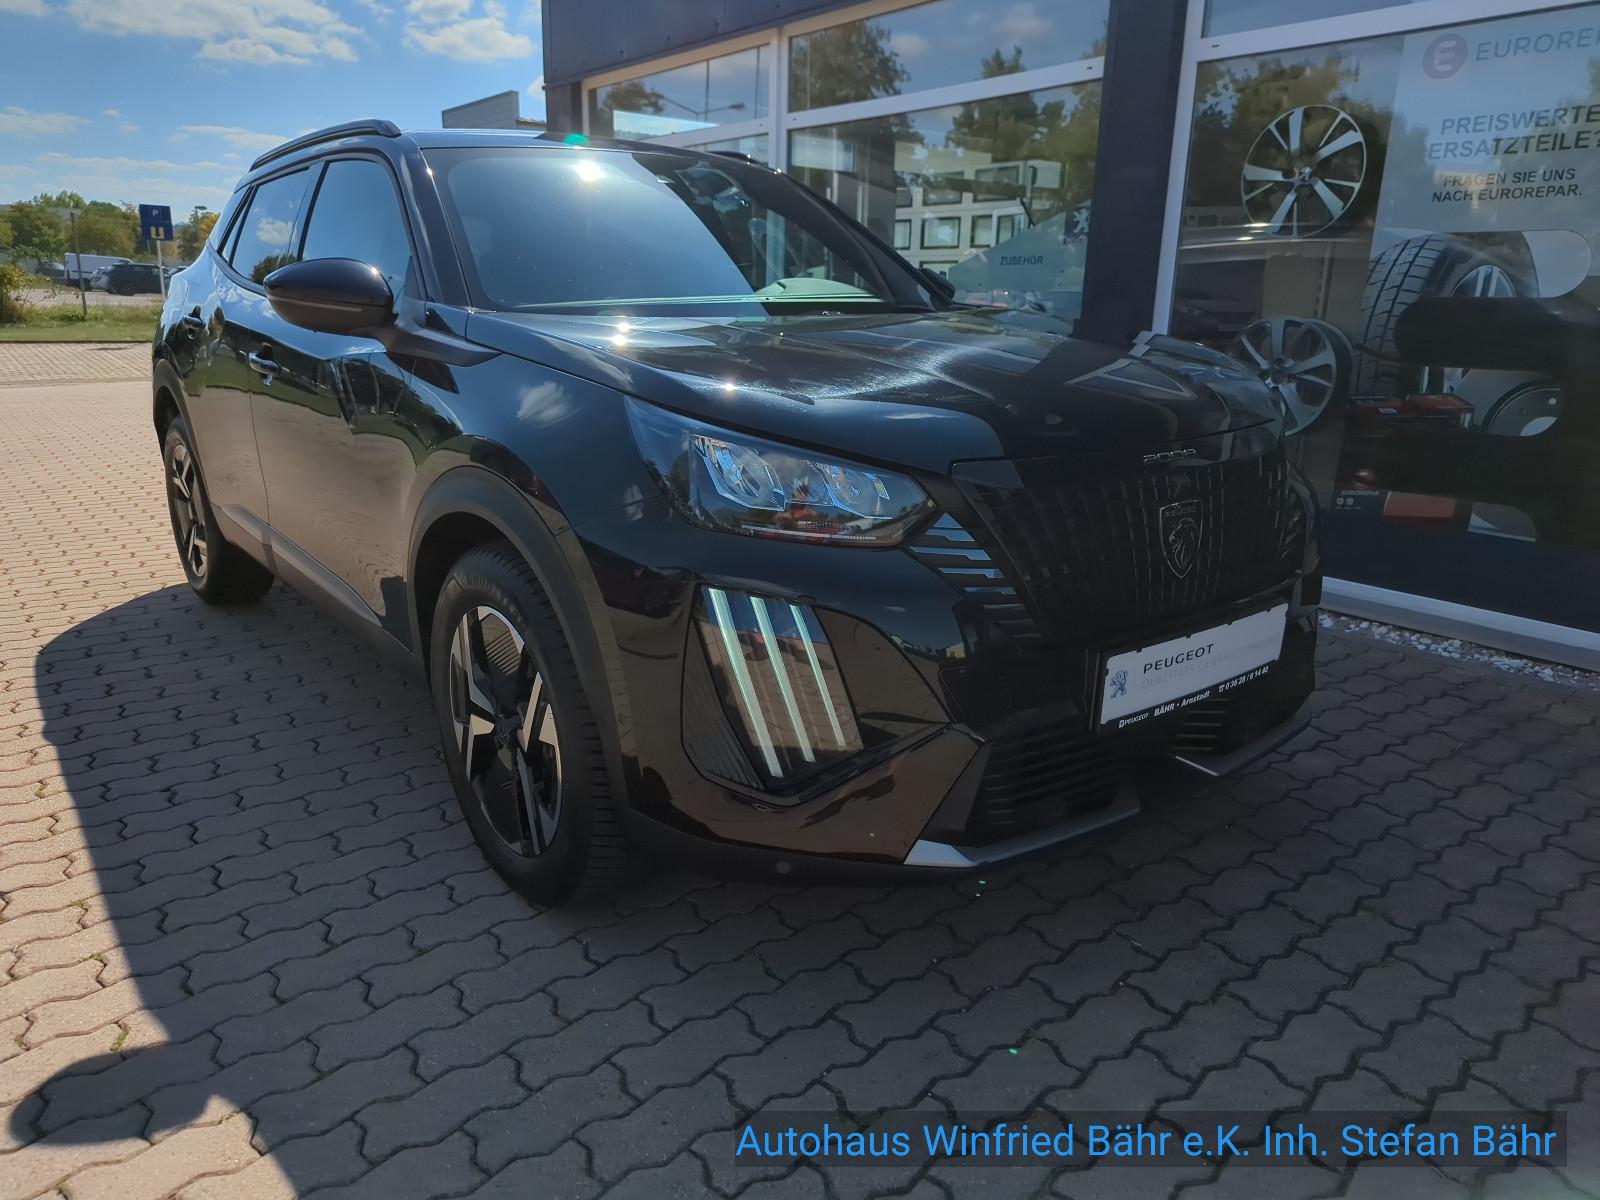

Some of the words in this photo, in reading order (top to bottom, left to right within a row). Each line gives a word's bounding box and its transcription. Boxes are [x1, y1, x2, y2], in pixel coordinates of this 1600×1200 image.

[1476, 28, 1600, 62] EURORE
[1440, 103, 1600, 136] PREISWERTE
[1443, 173, 1507, 187] FRAGEN
[1511, 170, 1538, 184] SIE
[1542, 168, 1576, 182] UNS
[1432, 189, 1473, 203] NACH
[1478, 184, 1583, 201] EUROREPAR.
[1143, 643, 1216, 675] PEUGEOT
[1154, 703, 1175, 717] BÄHR
[1181, 690, 1210, 707] Arnstadt
